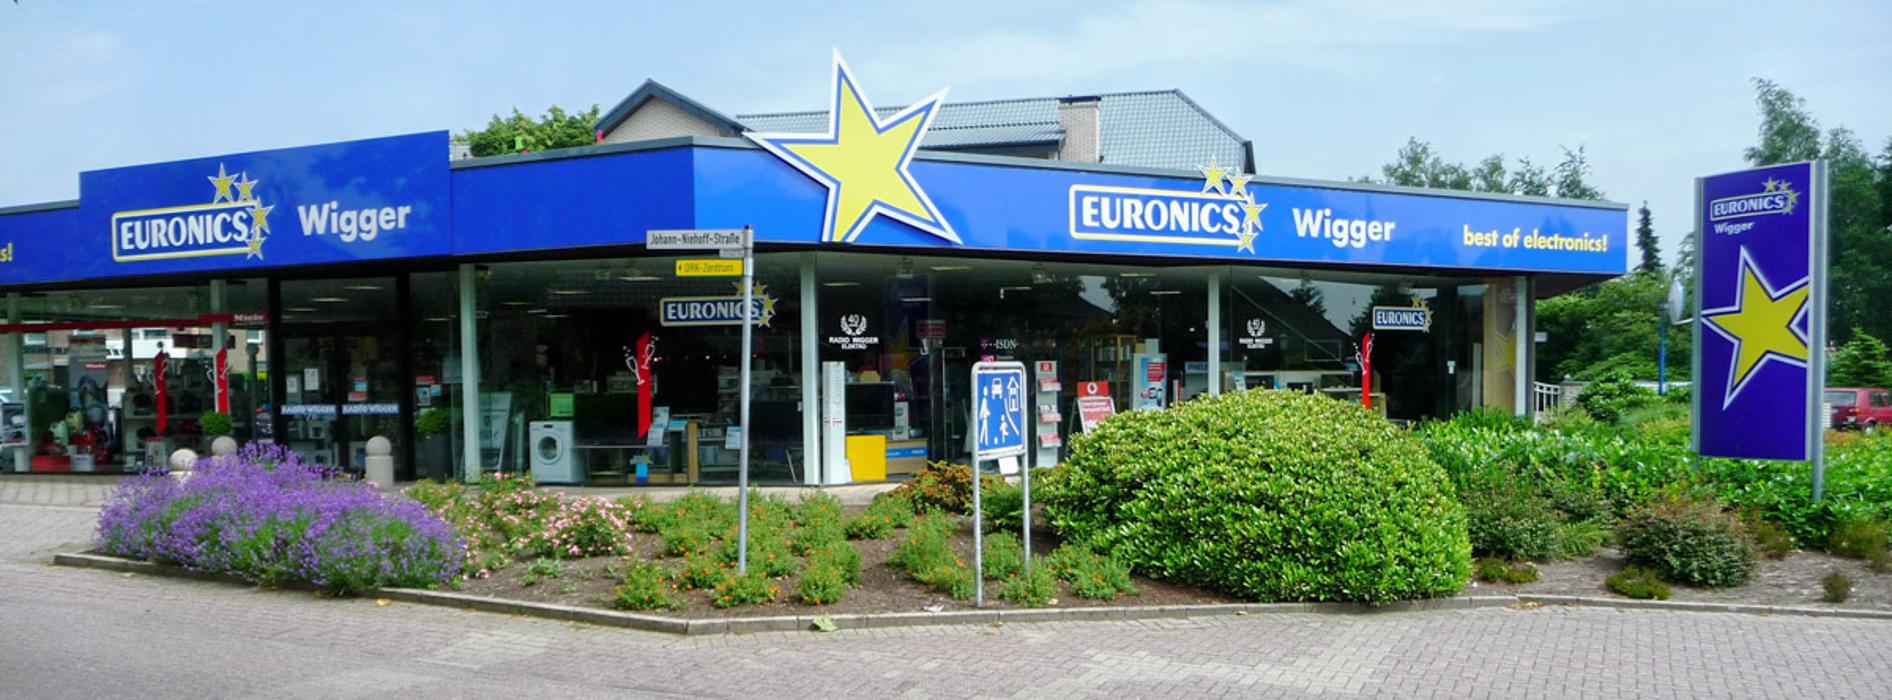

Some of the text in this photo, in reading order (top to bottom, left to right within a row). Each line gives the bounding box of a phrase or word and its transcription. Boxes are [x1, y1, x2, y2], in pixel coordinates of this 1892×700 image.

[1714, 194, 1784, 216] EURONICS
[120, 202, 412, 250] EURONICS Wigger
[1082, 195, 1396, 249] EURONICS Wigger
[1714, 221, 1755, 236] Wigger
[650, 232, 740, 246] Johann-Niehoff-Straße
[1463, 224, 1608, 252] best of electronics!
[684, 263, 735, 274] DRK-Zentrum
[234, 313, 265, 322] Miele
[848, 314, 860, 324] 40
[1376, 310, 1425, 326] EURONICS
[829, 336, 879, 344] RADIO WIGGER
